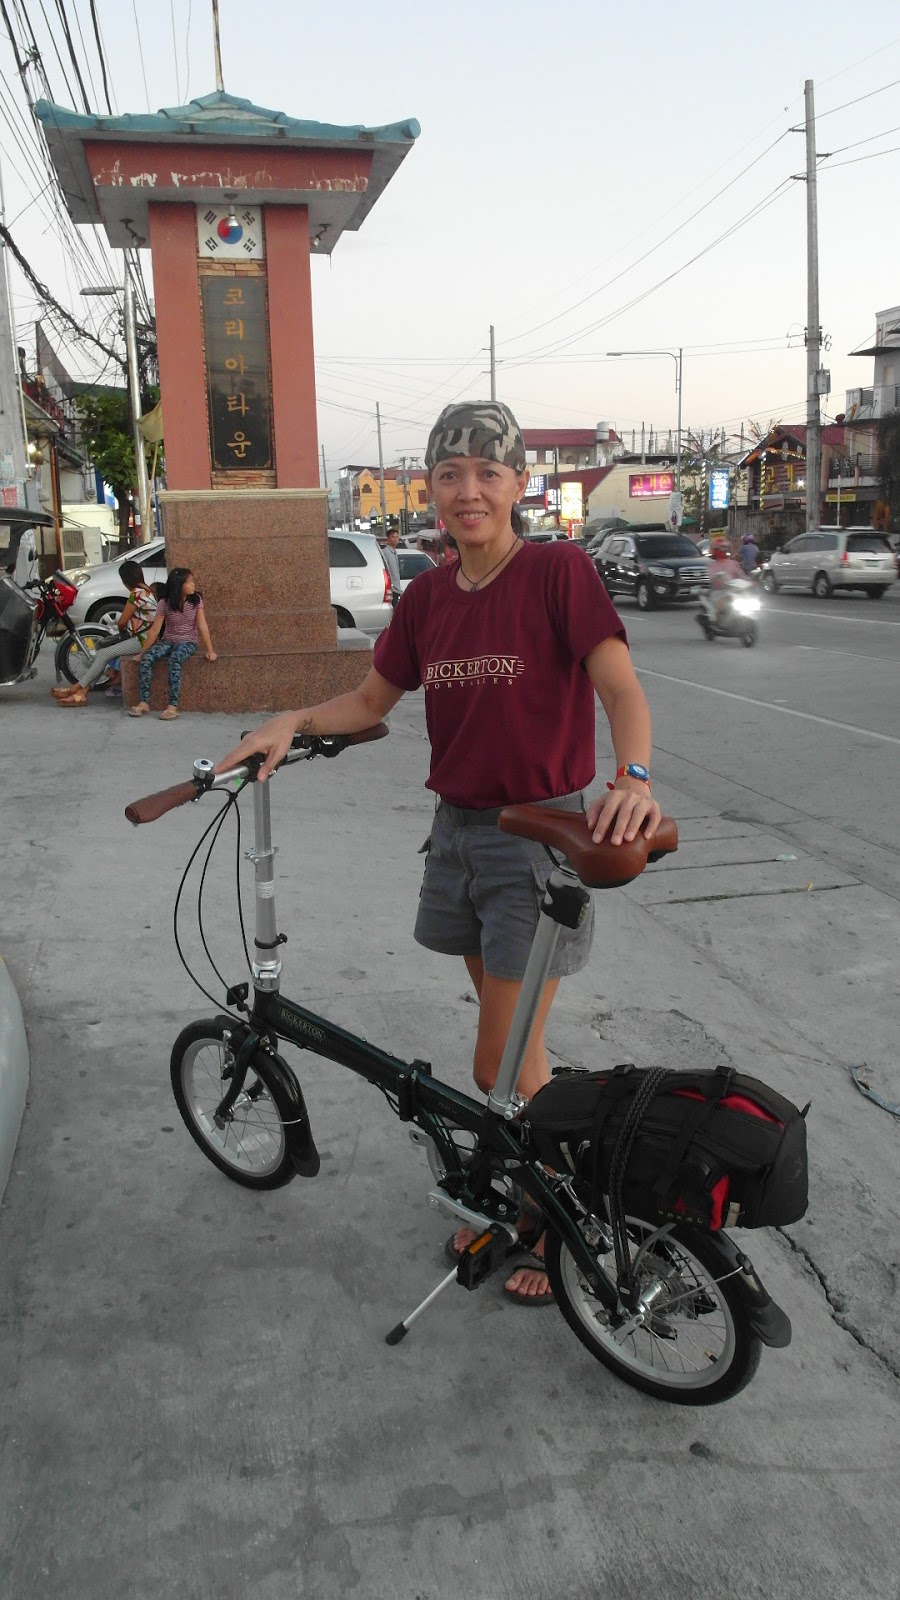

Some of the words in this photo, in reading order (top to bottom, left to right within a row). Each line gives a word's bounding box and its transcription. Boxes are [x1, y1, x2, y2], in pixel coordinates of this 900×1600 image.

[222, 287, 251, 458] 코리아타운
[426, 658, 516, 680] BICKERTON
[280, 1009, 323, 1038] BICKERTON
